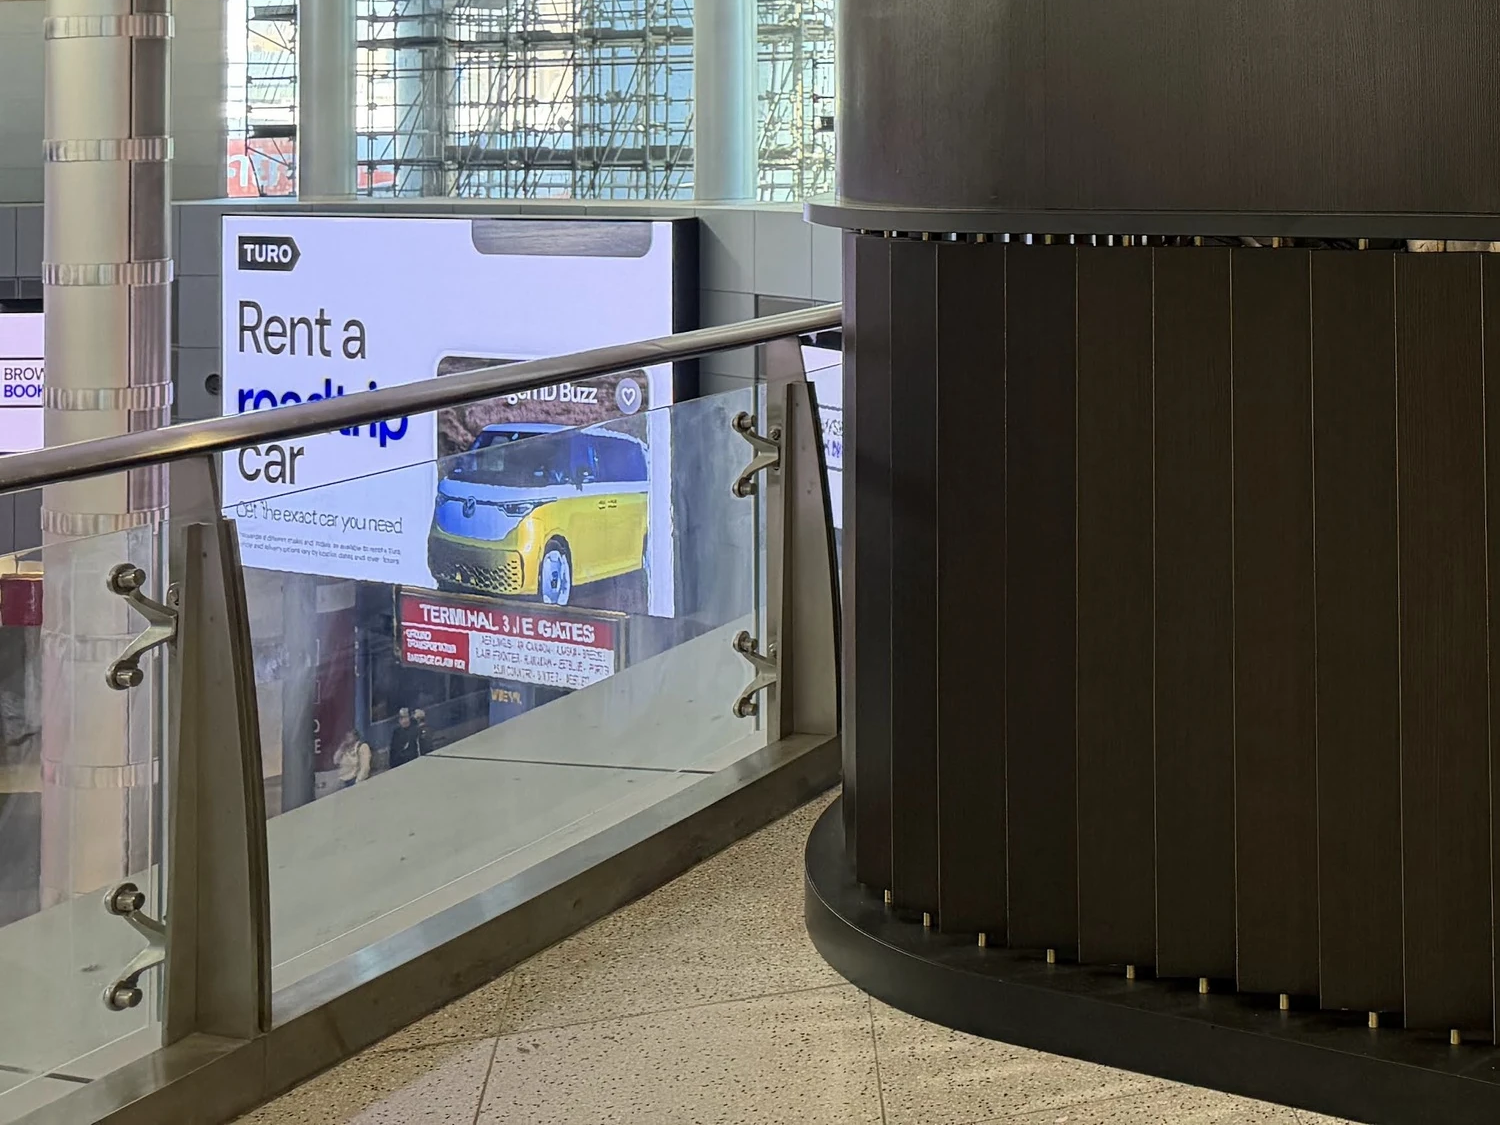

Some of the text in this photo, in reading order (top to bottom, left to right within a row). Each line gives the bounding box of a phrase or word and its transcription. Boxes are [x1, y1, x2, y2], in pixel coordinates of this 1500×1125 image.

[243, 243, 293, 264] TURO
[238, 299, 367, 360] Rent a
[560, 382, 598, 404] Buzz
[238, 444, 305, 485] car
[283, 508, 317, 526] exact
[319, 512, 339, 527] car
[341, 515, 366, 533] you
[537, 619, 595, 643] GATES
